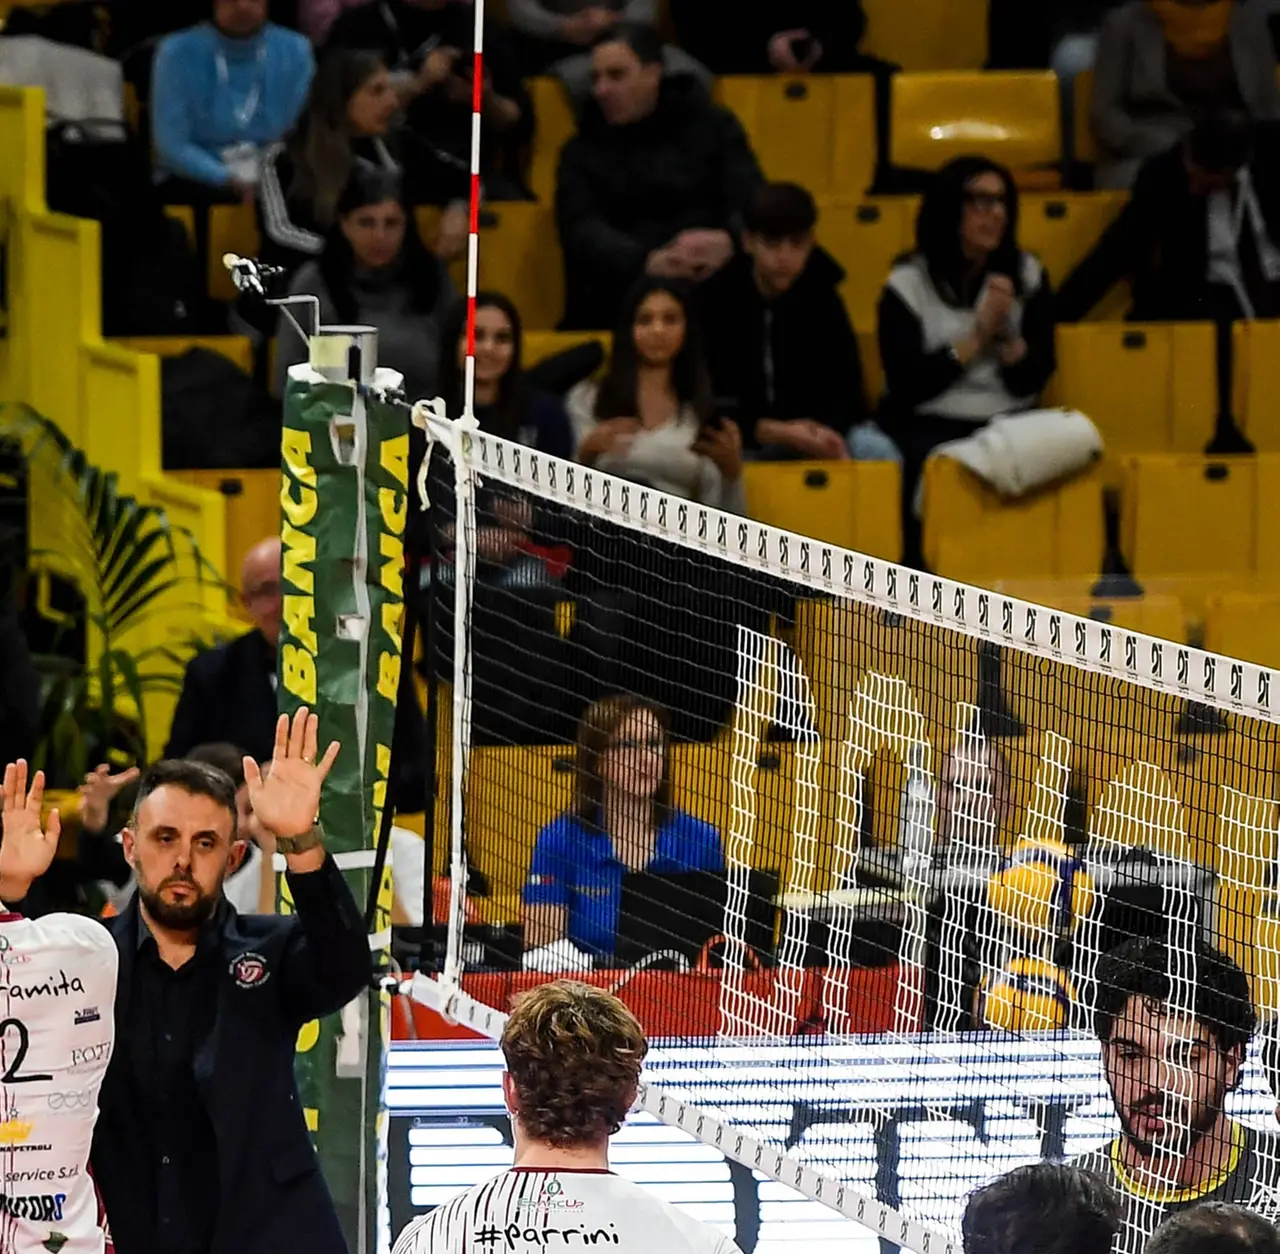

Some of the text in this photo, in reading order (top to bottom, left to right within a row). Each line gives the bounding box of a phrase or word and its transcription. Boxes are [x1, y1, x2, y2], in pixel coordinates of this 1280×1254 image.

[281, 427, 317, 704] BANCA
[377, 433, 410, 708] BANCA
[5, 1170, 55, 1182] service
[473, 1222, 619, 1251] #parrini
